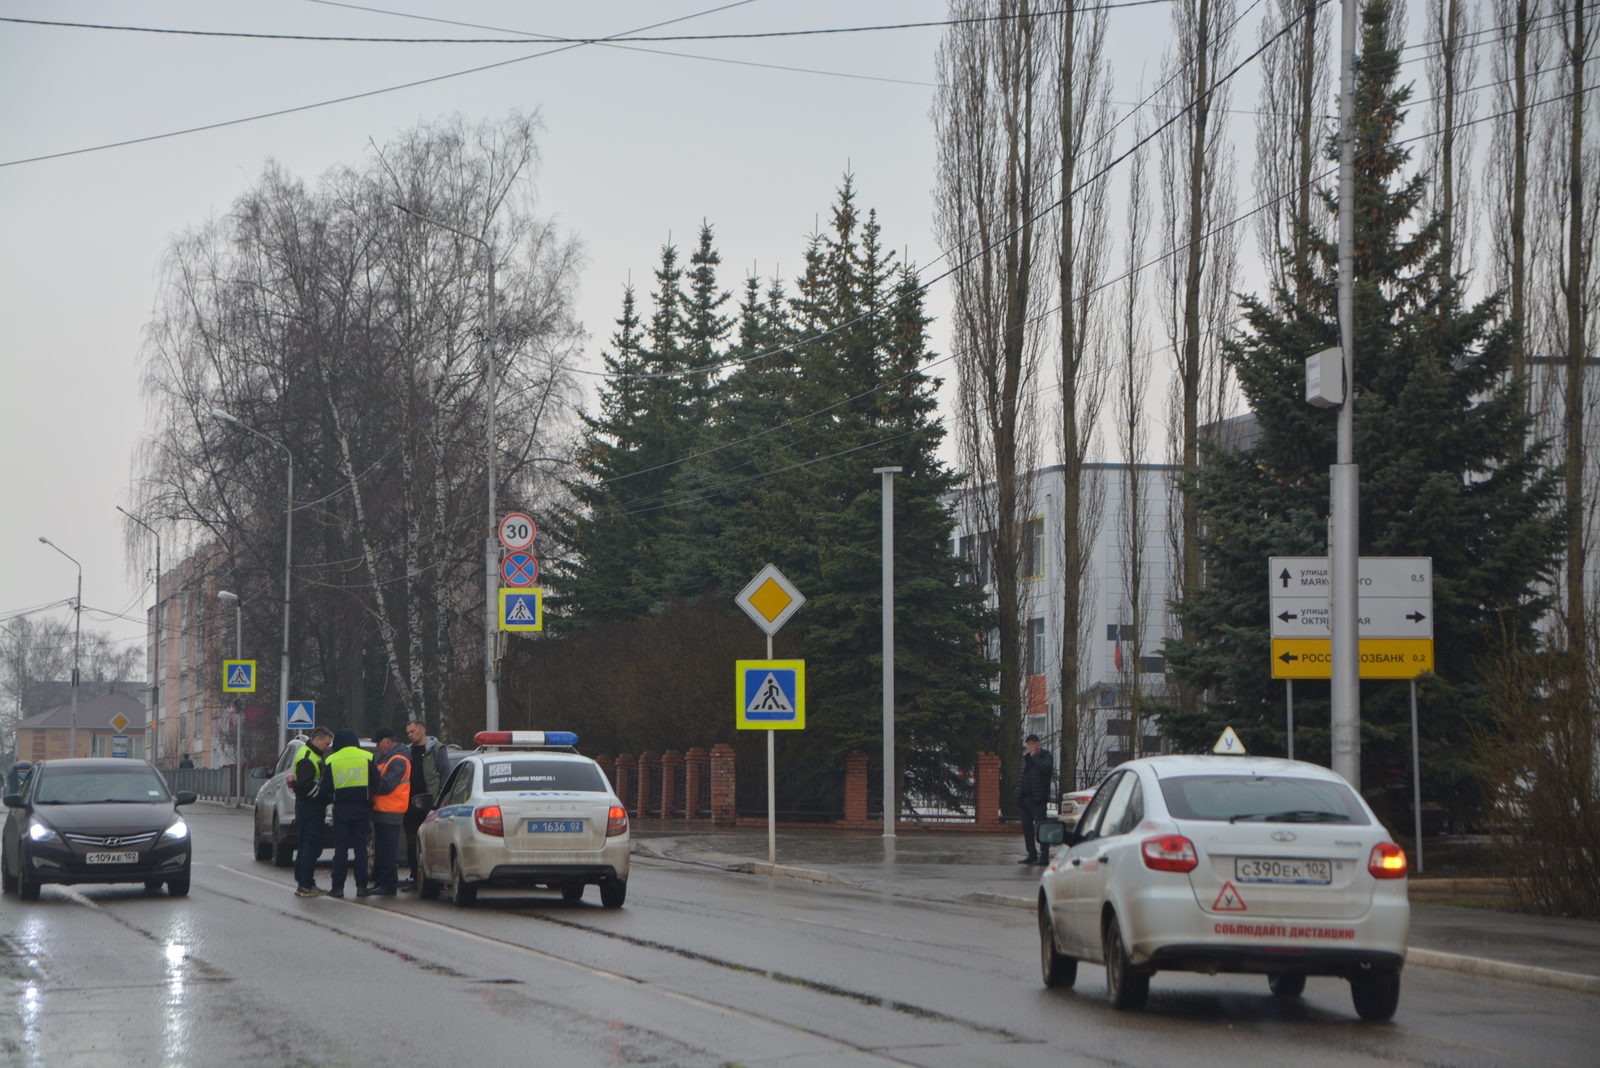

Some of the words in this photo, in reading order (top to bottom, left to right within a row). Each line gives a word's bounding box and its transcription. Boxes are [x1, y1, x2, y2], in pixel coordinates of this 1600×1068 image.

[506, 524, 528, 539] 30
[1300, 569, 1327, 577] улица
[1411, 574, 1425, 583] 0,5
[1301, 608, 1328, 617] улица
[1412, 654, 1426, 663] 0,2
[336, 767, 366, 783] ДПС
[542, 823, 566, 831] 1636
[570, 821, 580, 829] 02
[123, 852, 137, 860] 102
[1305, 862, 1326, 875] 102
[1214, 923, 1287, 938] СОБЛЮДАЙТЕ
[1289, 926, 1355, 940] ДИСТАНЦИЮ
